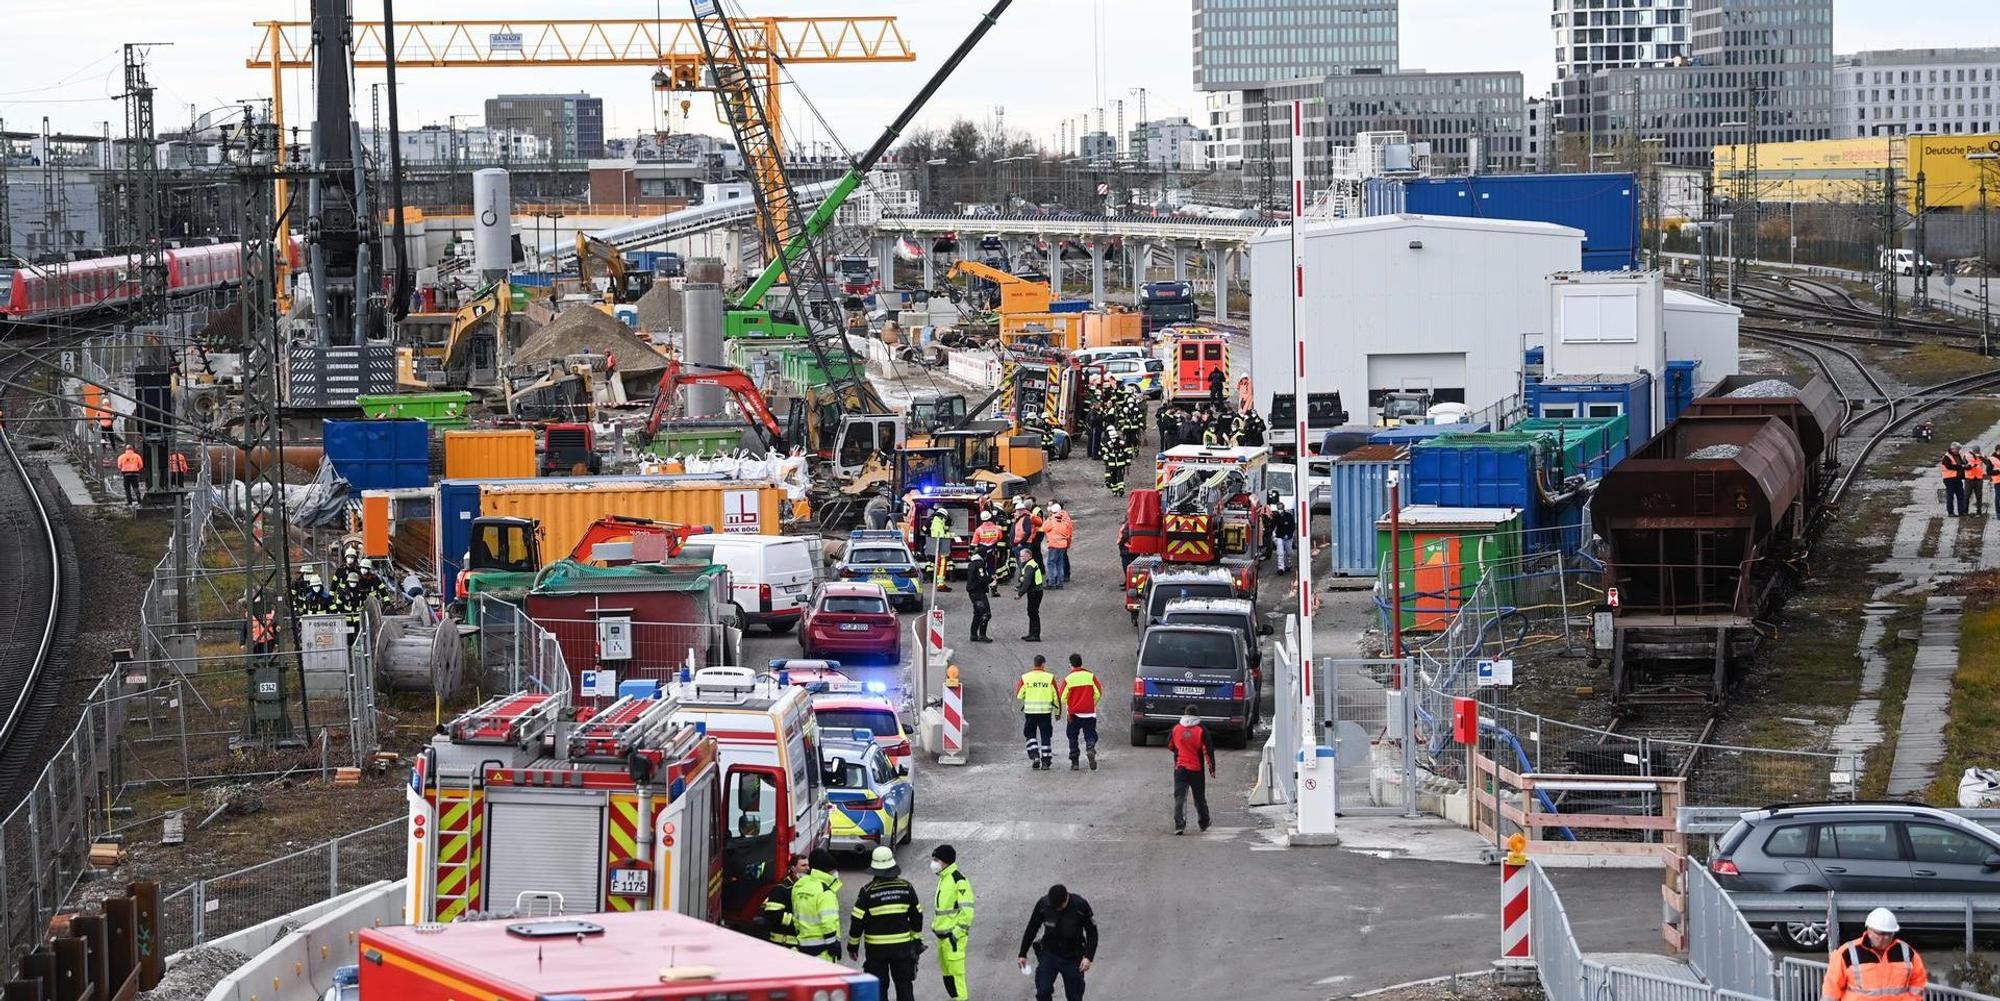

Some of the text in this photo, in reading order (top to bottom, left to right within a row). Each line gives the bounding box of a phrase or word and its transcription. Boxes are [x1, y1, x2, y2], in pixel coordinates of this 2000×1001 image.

[1925, 145, 1985, 155] Deutsche Post
[627, 871, 635, 881] M
[612, 881, 619, 890] F
